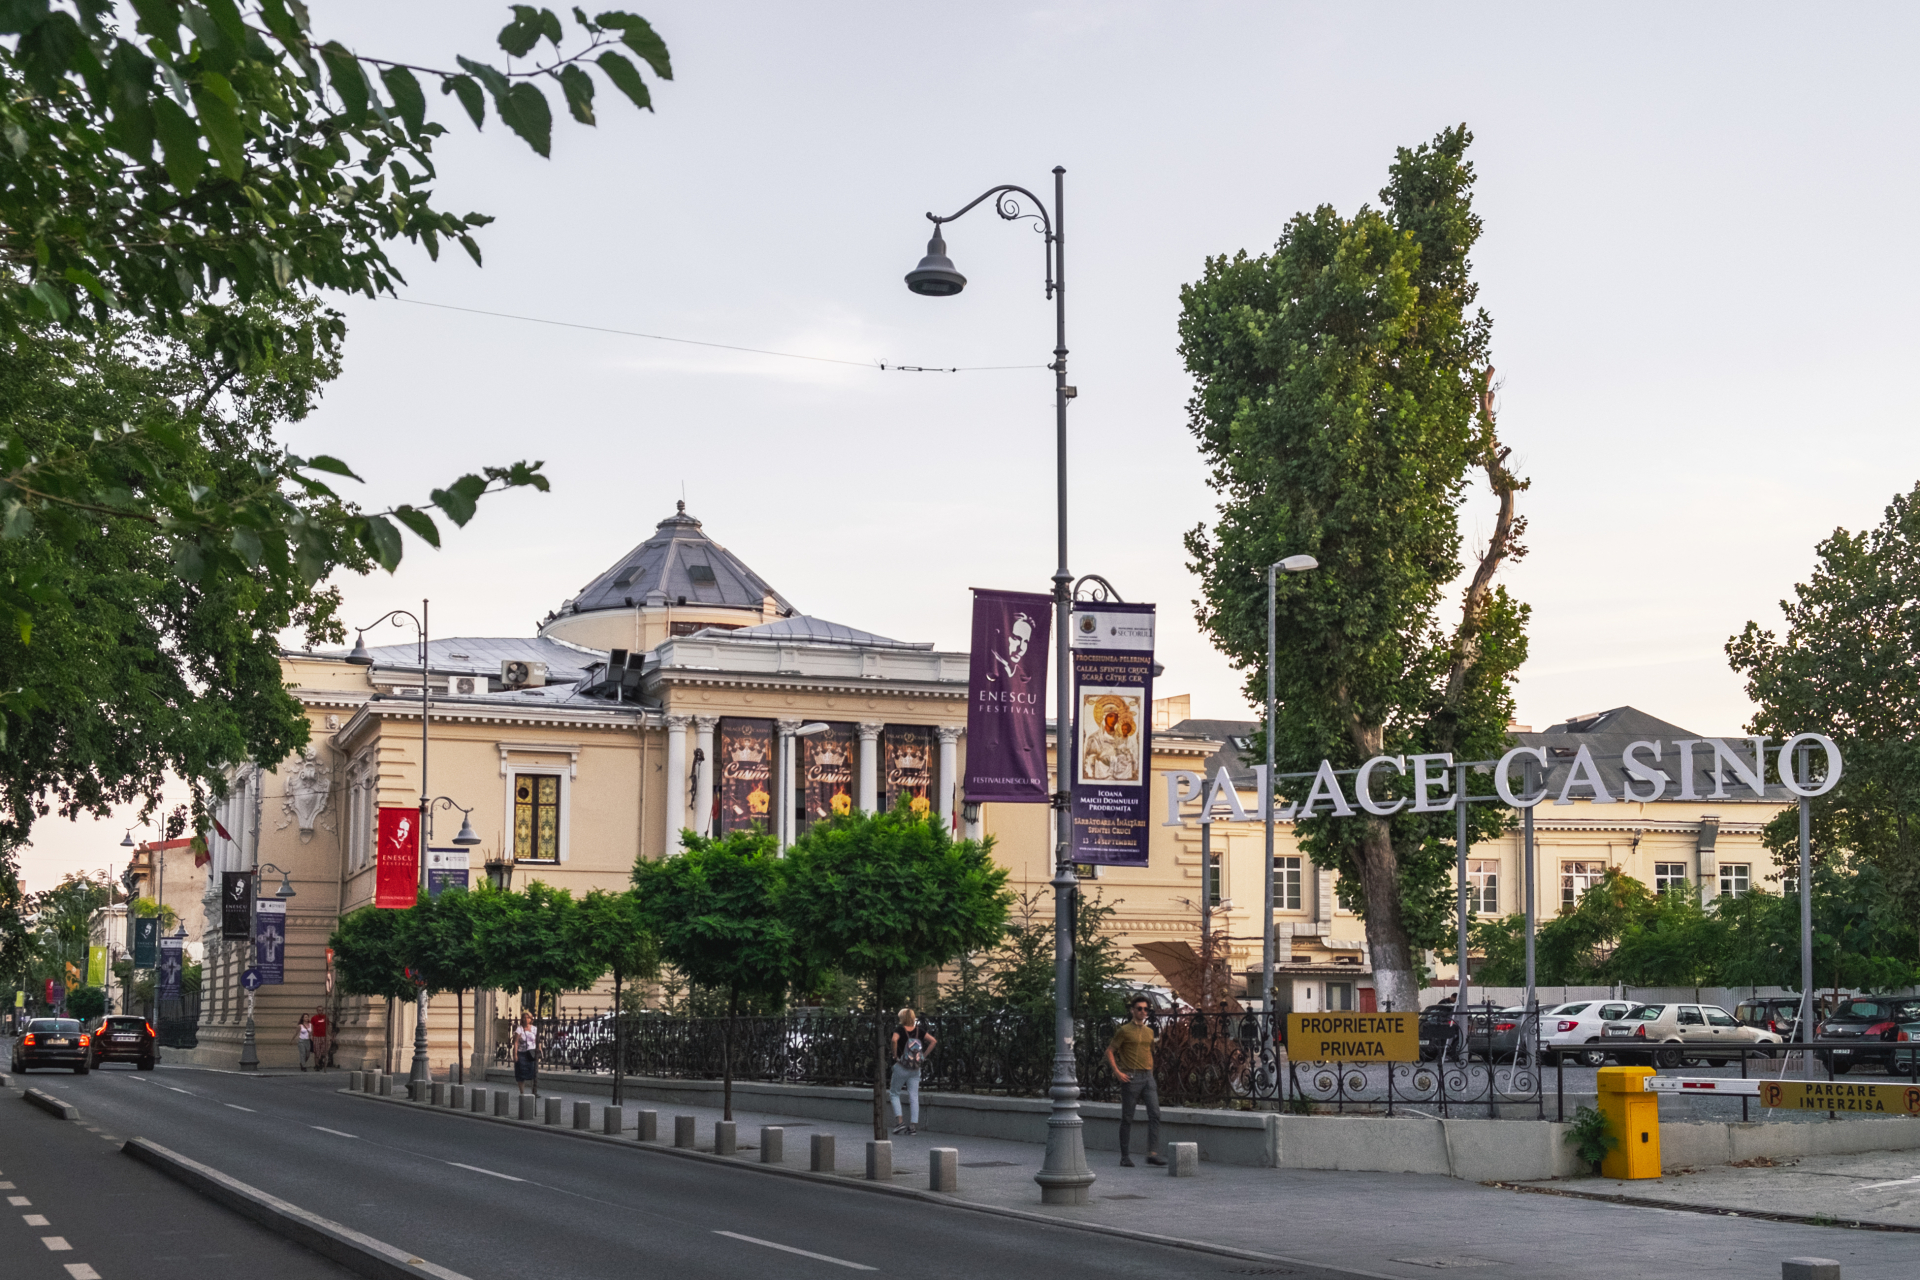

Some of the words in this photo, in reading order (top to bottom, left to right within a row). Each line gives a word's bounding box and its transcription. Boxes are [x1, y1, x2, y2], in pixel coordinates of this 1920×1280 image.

[1077, 665, 1098, 673] CALEA
[1100, 666, 1126, 674] SFINTEI
[1129, 675, 1144, 683] CER
[979, 690, 1037, 704] ENESCU
[979, 705, 1036, 715] FESTIVAL
[724, 761, 770, 780] Casino
[807, 764, 851, 784] Casino
[888, 768, 930, 787] Casino
[973, 776, 1041, 785] FESTIVALENESCU.RO
[1161, 752, 1458, 827] PALACE
[1494, 732, 1843, 808] CASINO
[1111, 827, 1131, 835] CRUCI
[382, 854, 413, 862] ENESCU
[1301, 1018, 1405, 1033] PROPRIETATE
[1321, 1041, 1385, 1056] PRIVATA
[1805, 1084, 1877, 1097] PARCARE
[1800, 1097, 1885, 1111] INTERZISA
